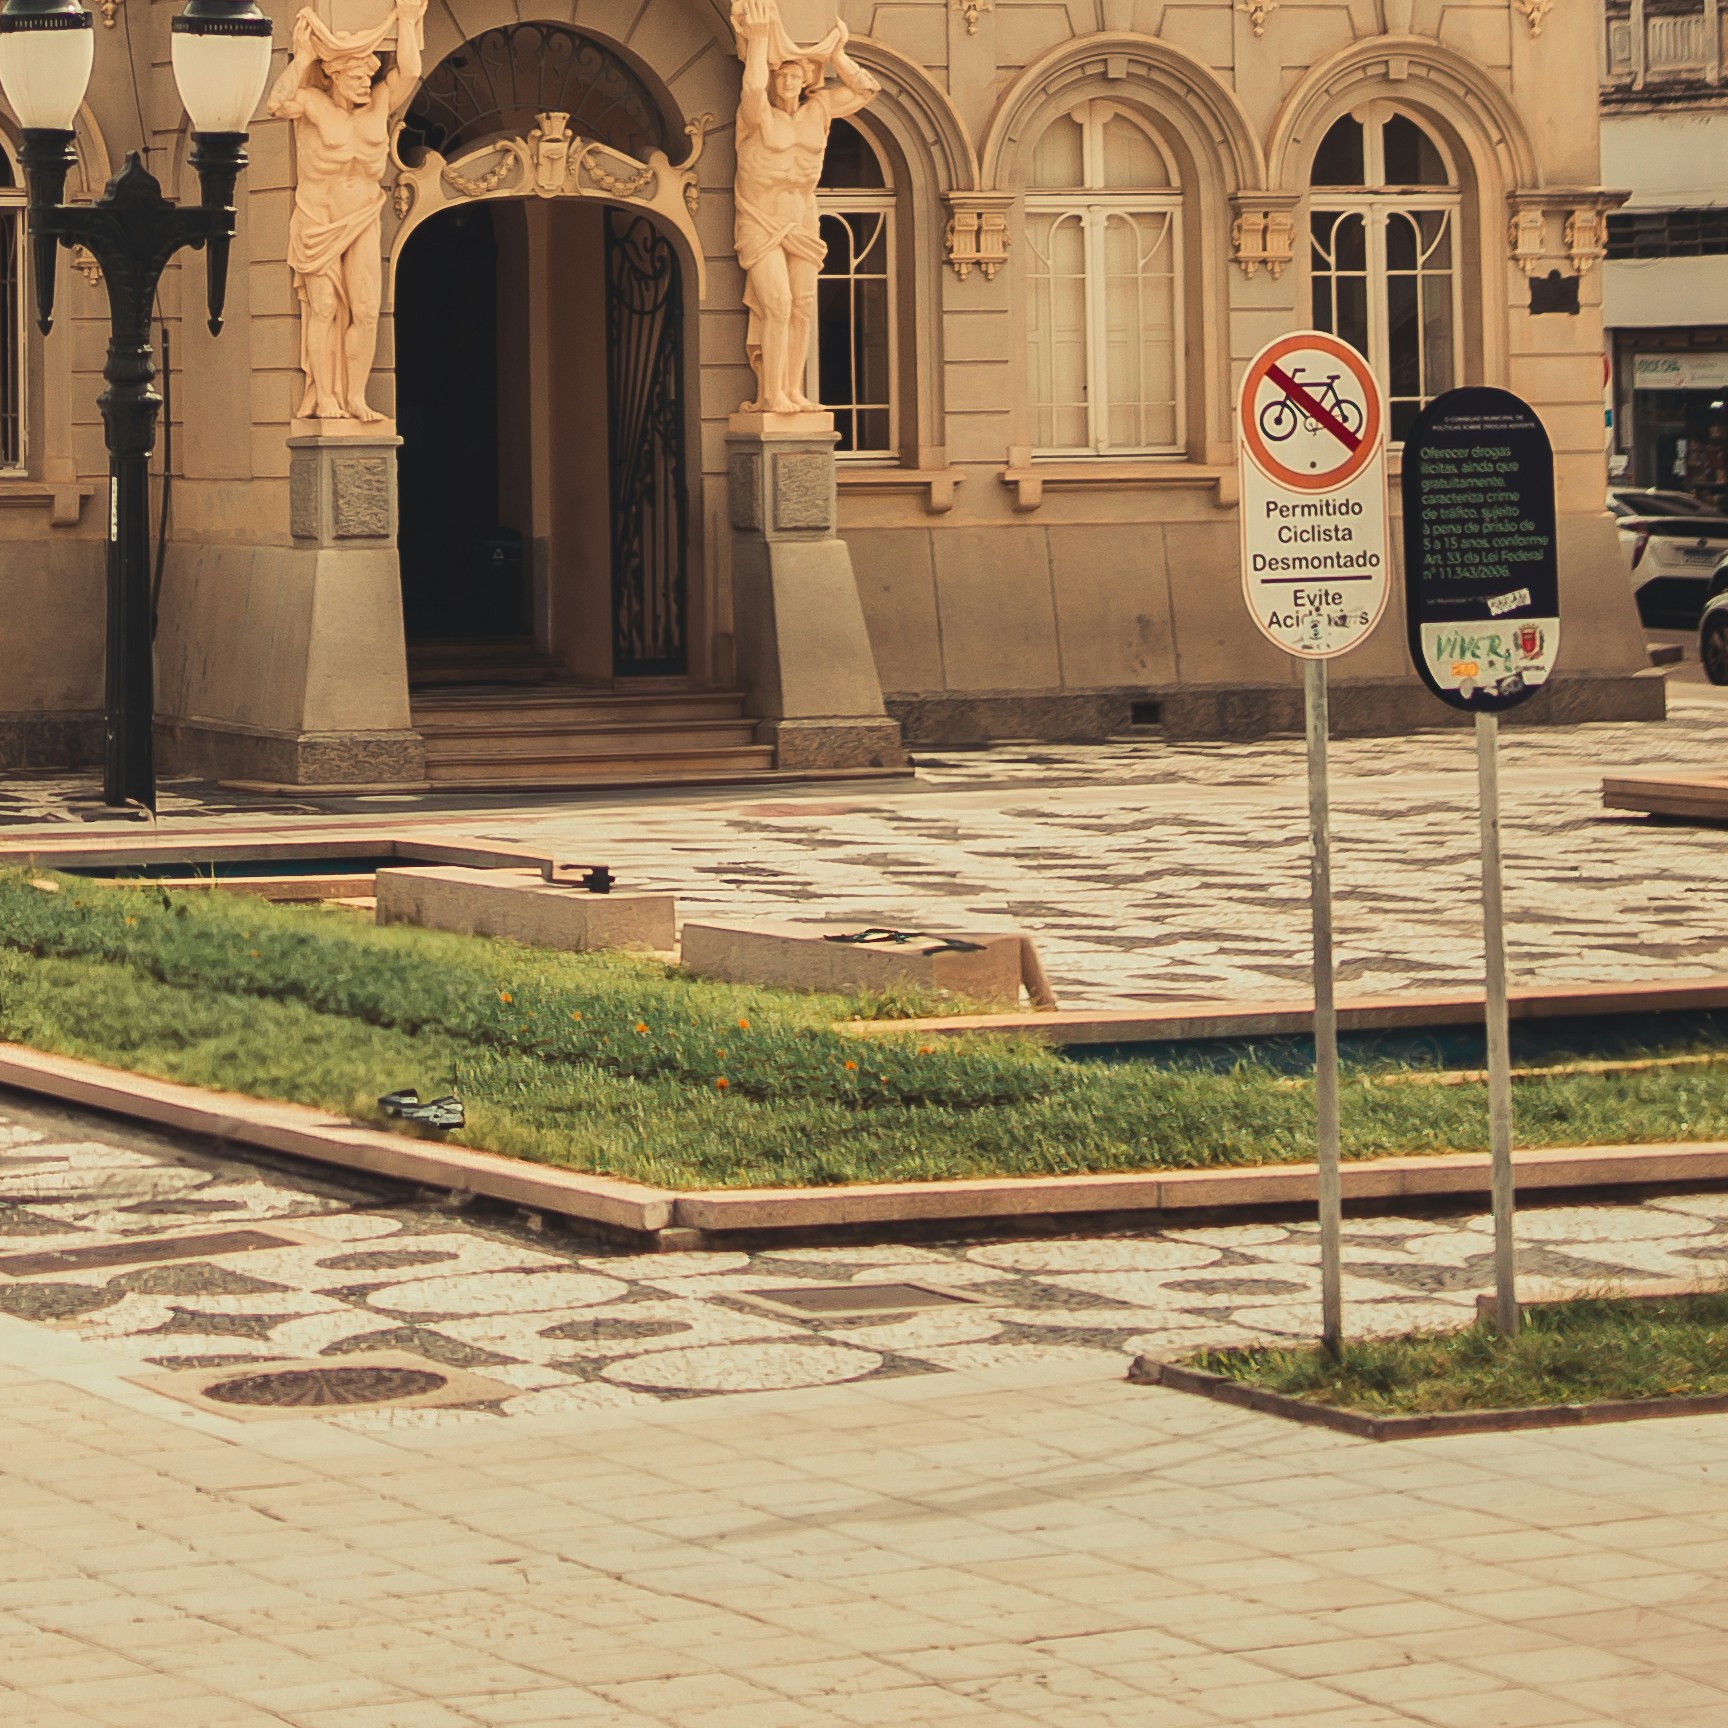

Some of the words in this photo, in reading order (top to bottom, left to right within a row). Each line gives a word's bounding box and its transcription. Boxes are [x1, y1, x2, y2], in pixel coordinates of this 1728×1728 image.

[1266, 498, 1363, 519] Permitido
[1277, 524, 1353, 544] Ciclista
[1252, 549, 1380, 572] Desmontado
[1293, 588, 1343, 607] Evite
